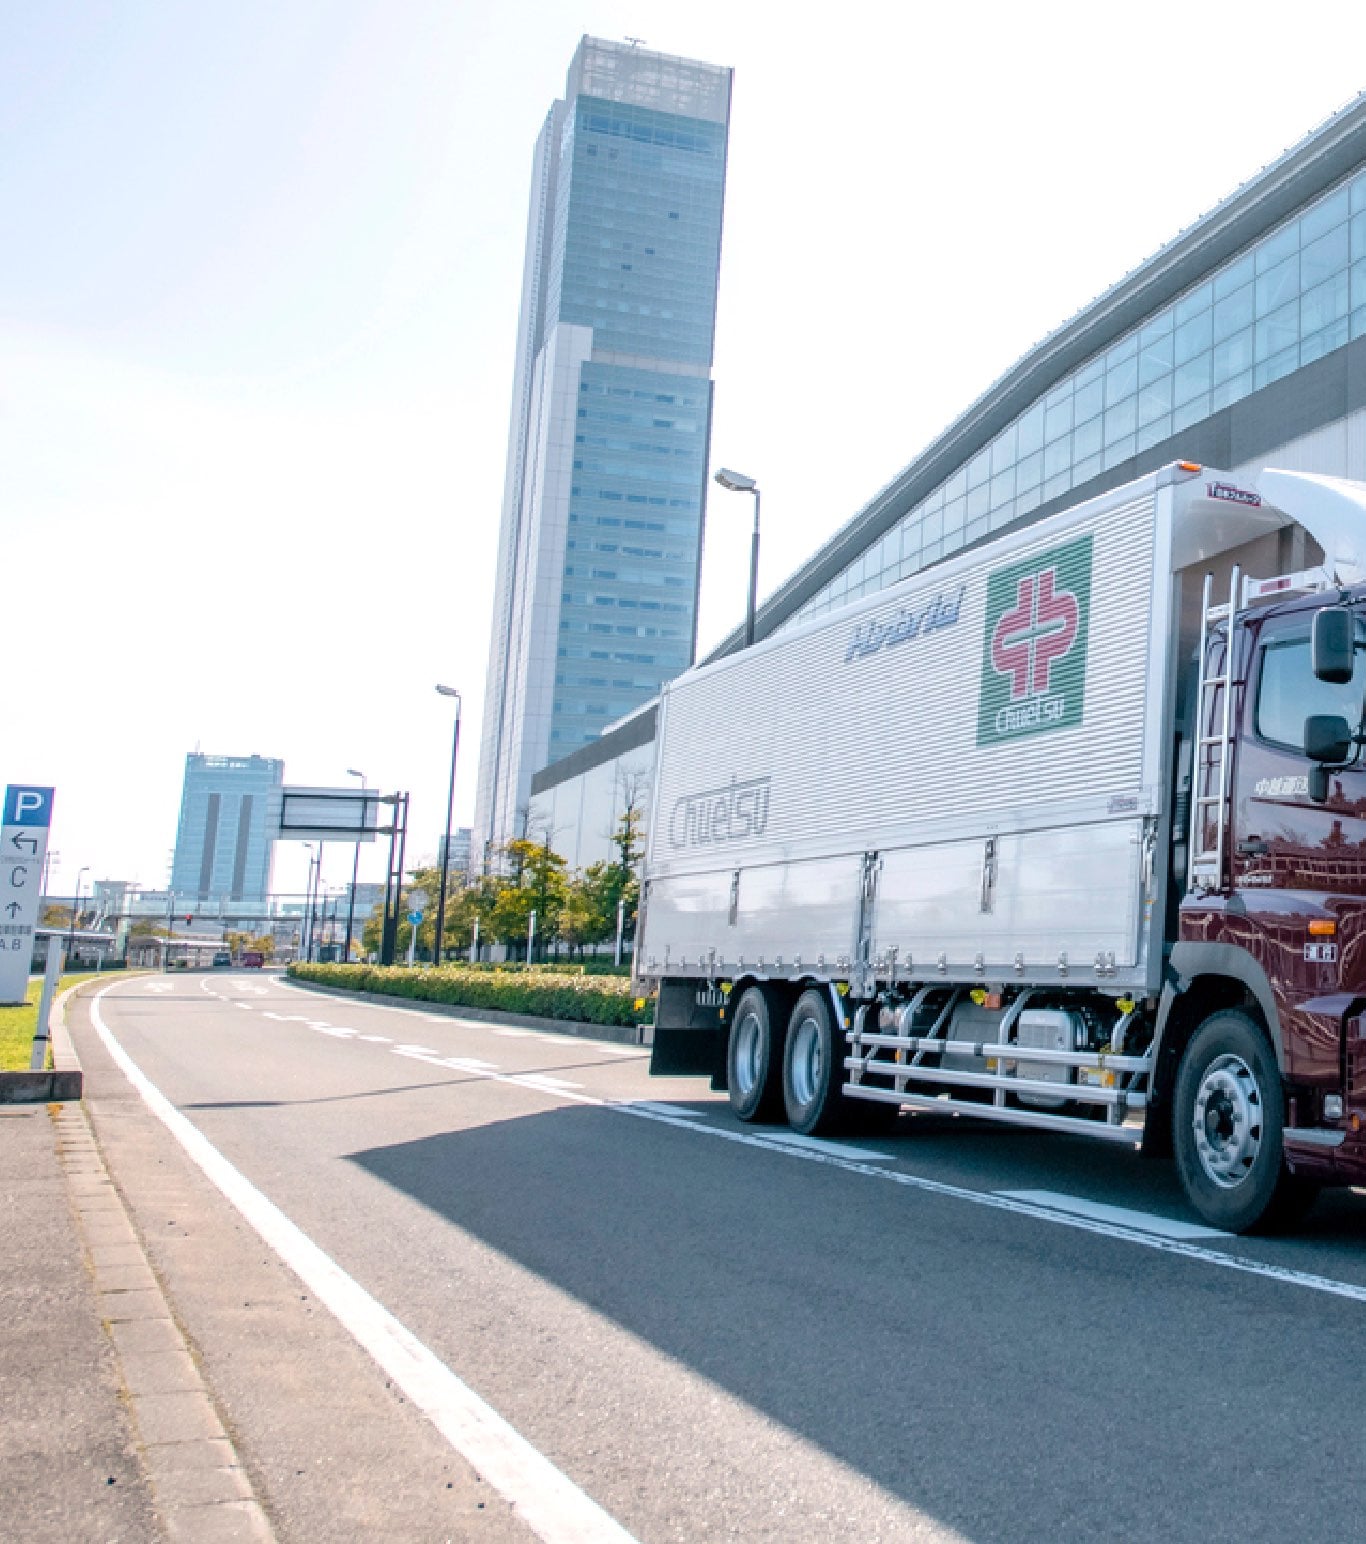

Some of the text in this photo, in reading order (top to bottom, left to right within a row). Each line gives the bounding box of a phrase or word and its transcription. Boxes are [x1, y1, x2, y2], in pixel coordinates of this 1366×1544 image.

[14, 791, 44, 821] P
[667, 775, 771, 847] Chuetsu
[11, 865, 28, 888] C
